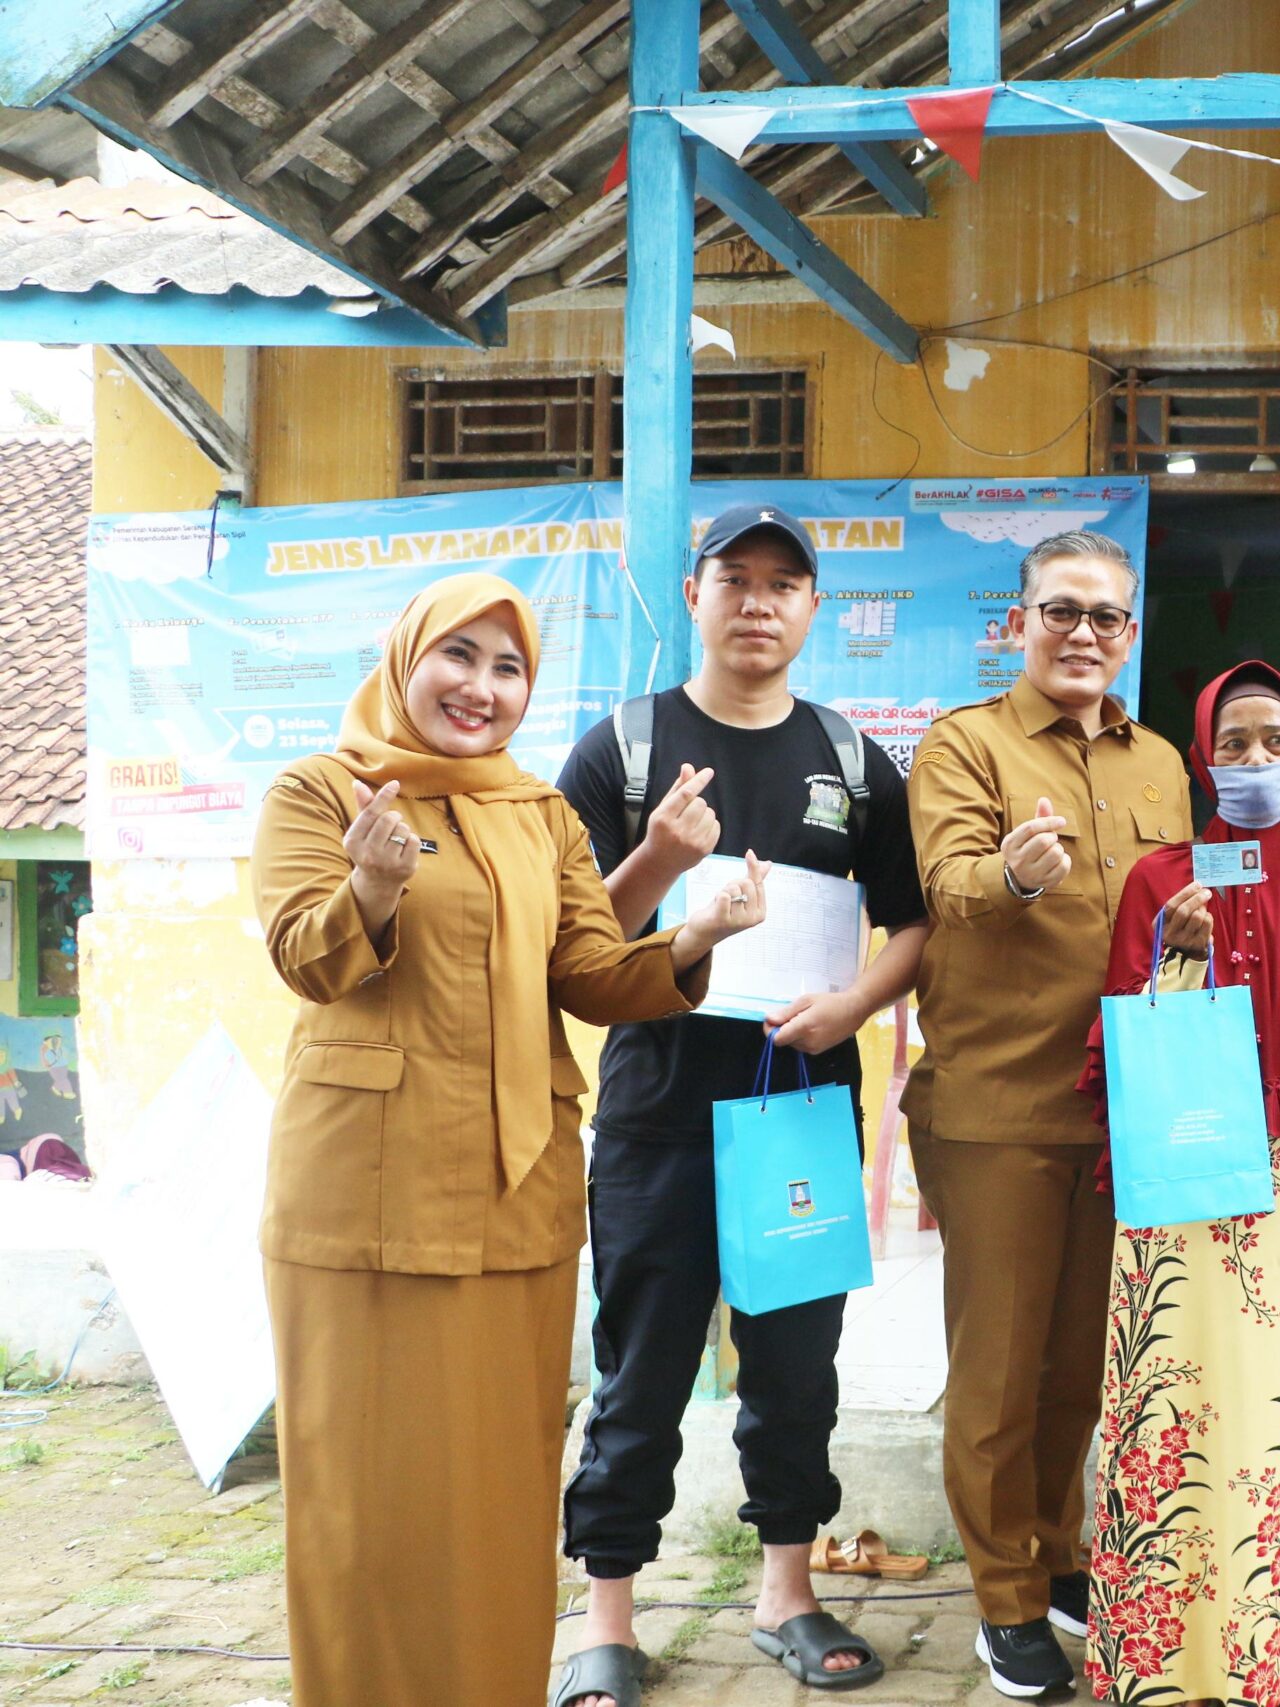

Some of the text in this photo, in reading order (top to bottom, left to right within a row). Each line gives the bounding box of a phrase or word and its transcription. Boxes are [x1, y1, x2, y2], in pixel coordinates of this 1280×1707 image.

[914, 490, 970, 499] BerAKHLAK
[976, 487, 1026, 498] #GISA
[192, 531, 231, 541] Pencatan
[269, 540, 365, 573] JENIS
[368, 527, 540, 564] LAYANAN
[546, 523, 622, 551] DAN
[821, 589, 915, 600] 6. Aktivasi IKD
[969, 589, 1024, 600] 7. Perek
[850, 708, 880, 719] Kode
[882, 708, 899, 719] QR
[901, 708, 929, 719] Code
[859, 725, 929, 736] wnload Form
[278, 734, 298, 748] 23
[109, 760, 179, 789] GRATIS!
[209, 790, 243, 808] BIAYA
